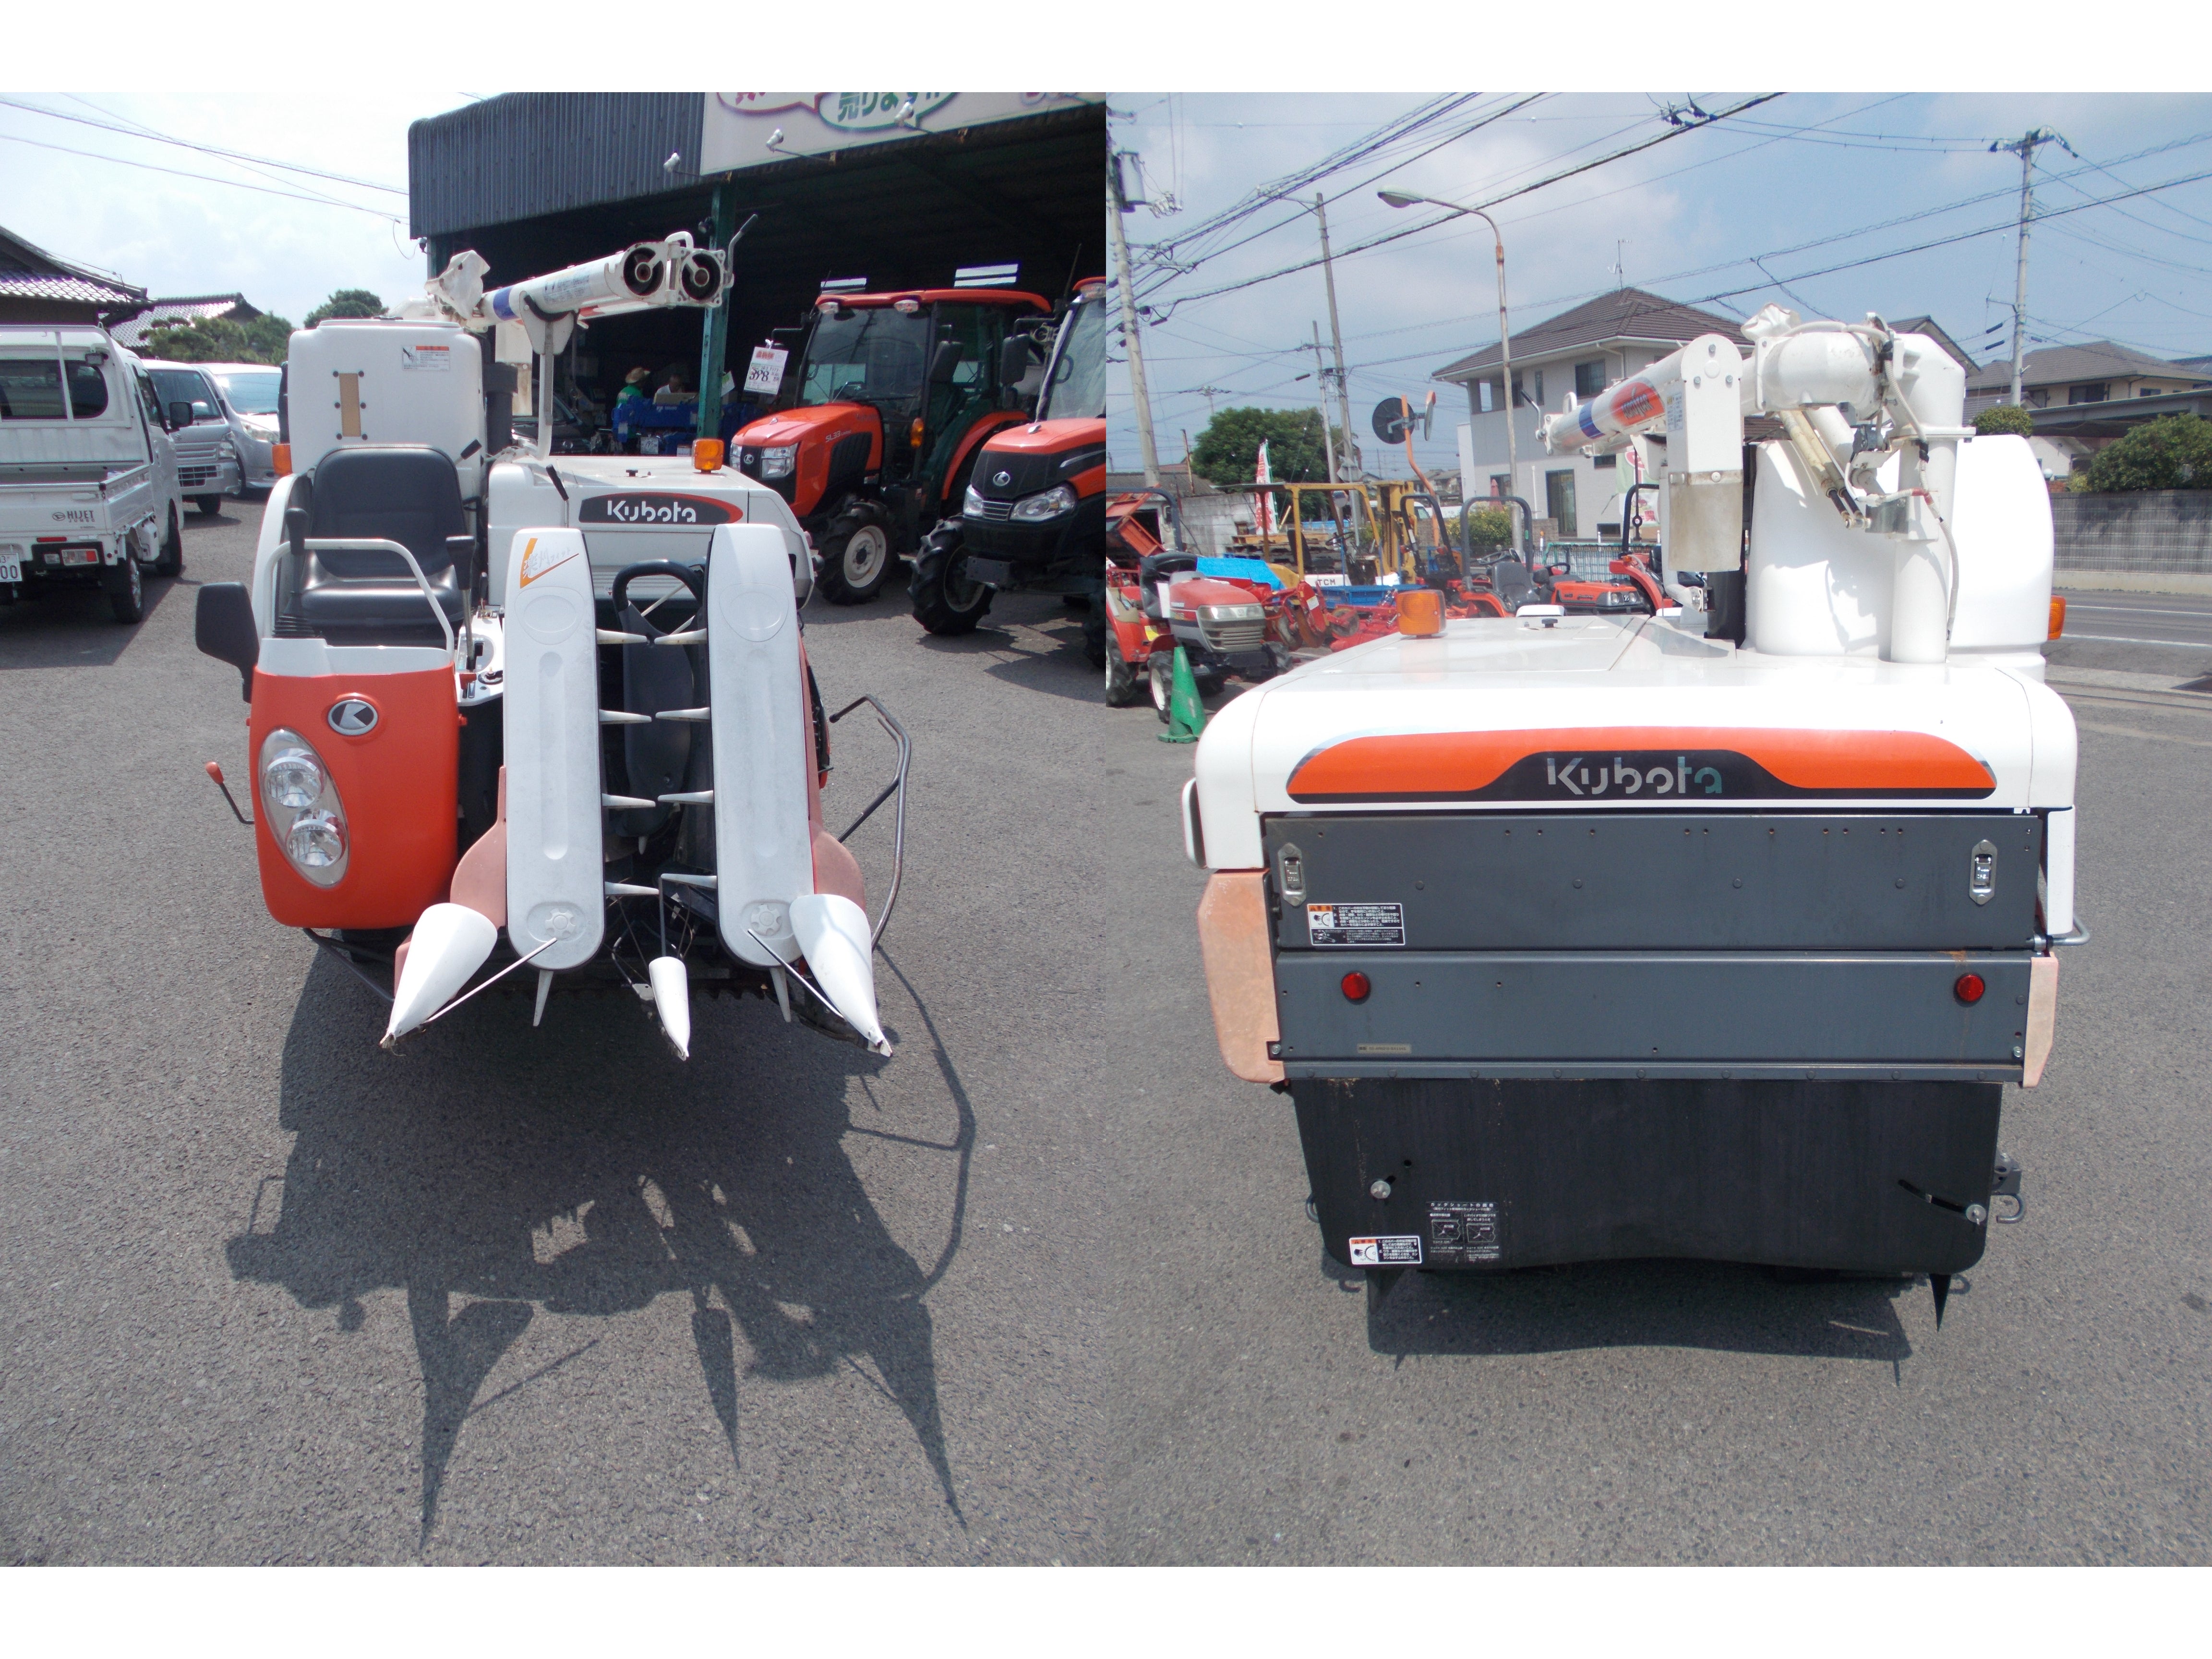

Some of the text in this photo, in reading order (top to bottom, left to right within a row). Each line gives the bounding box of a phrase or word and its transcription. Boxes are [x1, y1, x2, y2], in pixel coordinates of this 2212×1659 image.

[67, 510, 94, 519] HIJET
[607, 500, 696, 523] Kubota
[1547, 756, 1722, 795] Kubota
